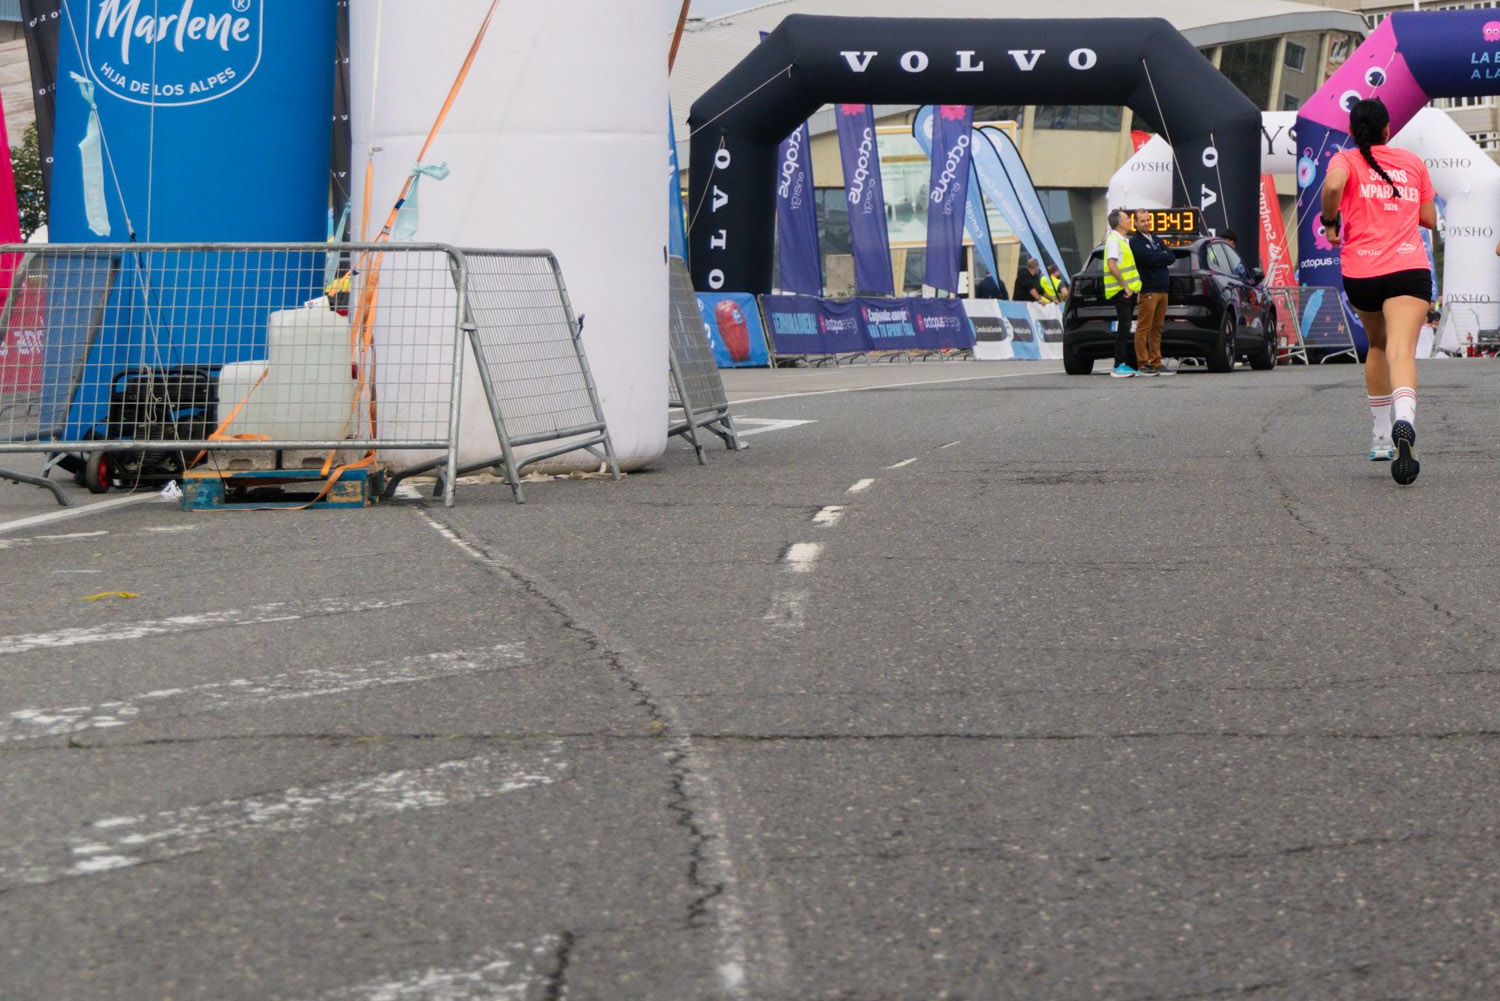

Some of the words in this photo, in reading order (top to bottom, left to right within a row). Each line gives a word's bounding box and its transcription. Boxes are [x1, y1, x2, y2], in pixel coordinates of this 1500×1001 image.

[840, 47, 1098, 73] VOLVO
[1471, 51, 1489, 64] LA
[100, 62, 127, 88] HIJA
[129, 80, 149, 94] DE
[153, 84, 184, 96] LOS
[189, 67, 236, 94] ALPES
[1470, 68, 1481, 79] A
[1131, 161, 1173, 173] OYSHO
[1424, 157, 1472, 169] OYSHO
[708, 148, 731, 290] OLVO
[1449, 226, 1493, 238] OYSHO
[1300, 257, 1333, 270] octopus
